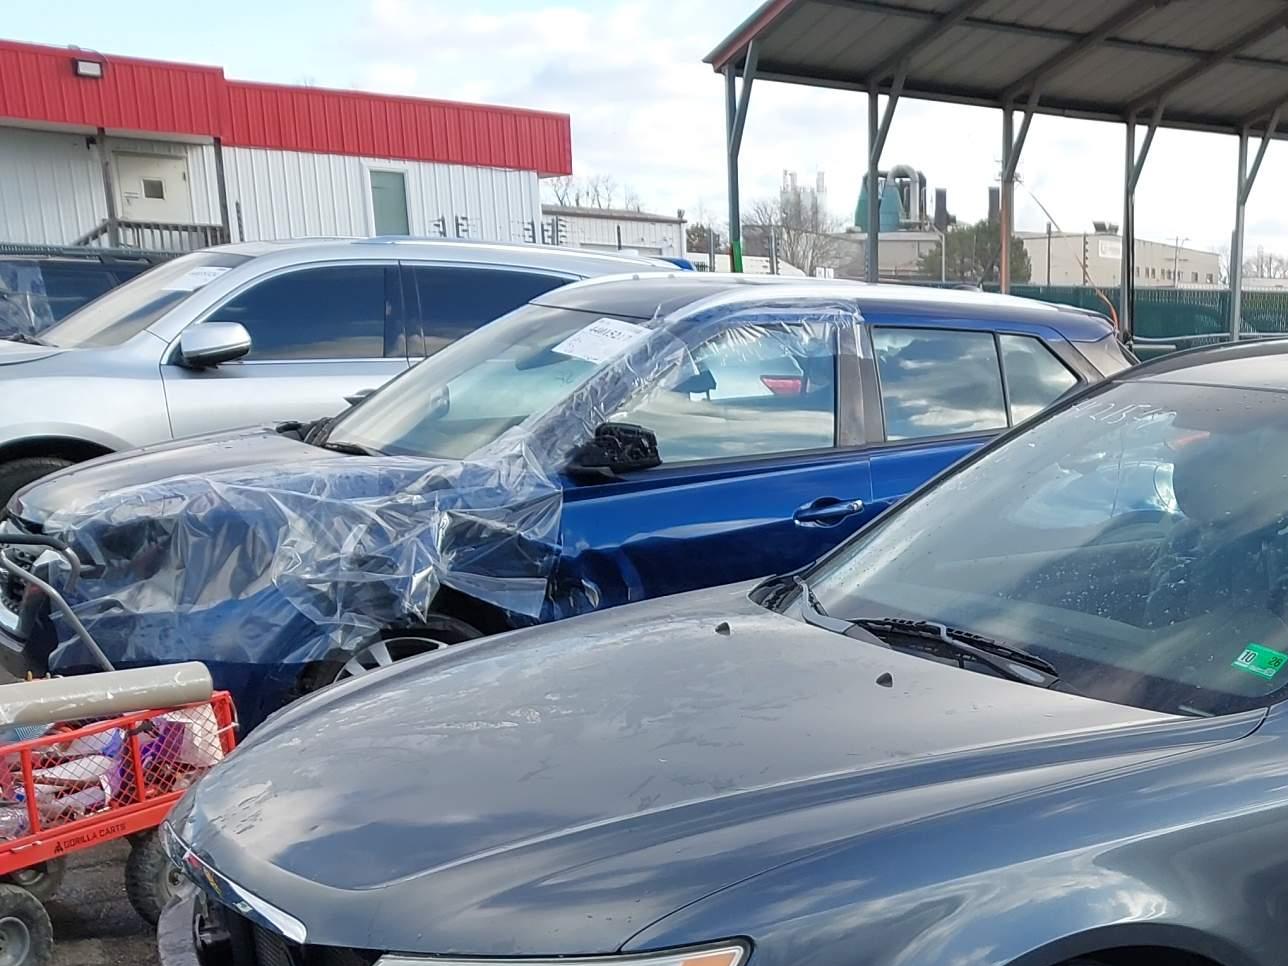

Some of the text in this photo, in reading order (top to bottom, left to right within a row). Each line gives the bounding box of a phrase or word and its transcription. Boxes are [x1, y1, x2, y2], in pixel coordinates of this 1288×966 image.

[1240, 650, 1284, 668] 10 26
[63, 823, 127, 849] GORILLA CARTS
